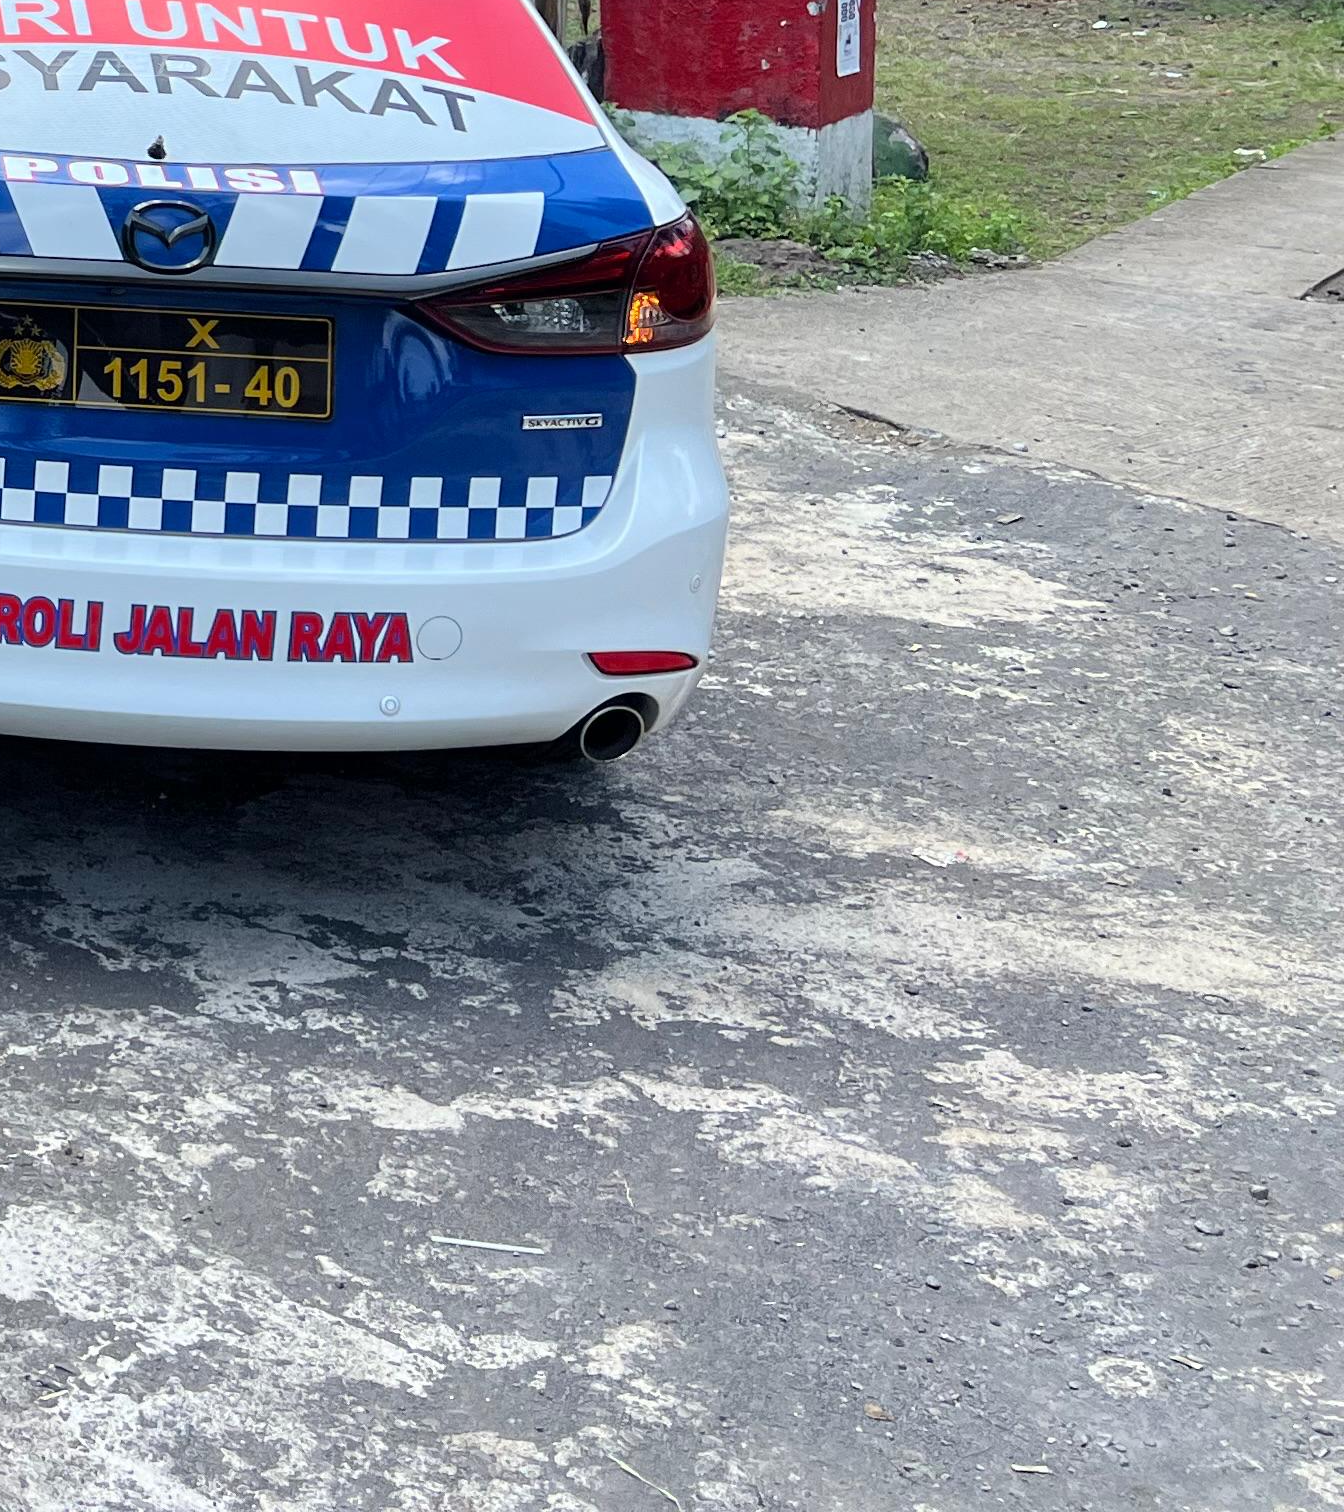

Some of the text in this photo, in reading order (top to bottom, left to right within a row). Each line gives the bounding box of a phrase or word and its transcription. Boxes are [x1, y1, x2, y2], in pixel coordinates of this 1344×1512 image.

[123, 0, 466, 81] UNTUK
[1, 155, 325, 195] POLISI
[185, 318, 221, 350] X
[113, 603, 277, 661] JALAN
[287, 610, 414, 663] RAYA
